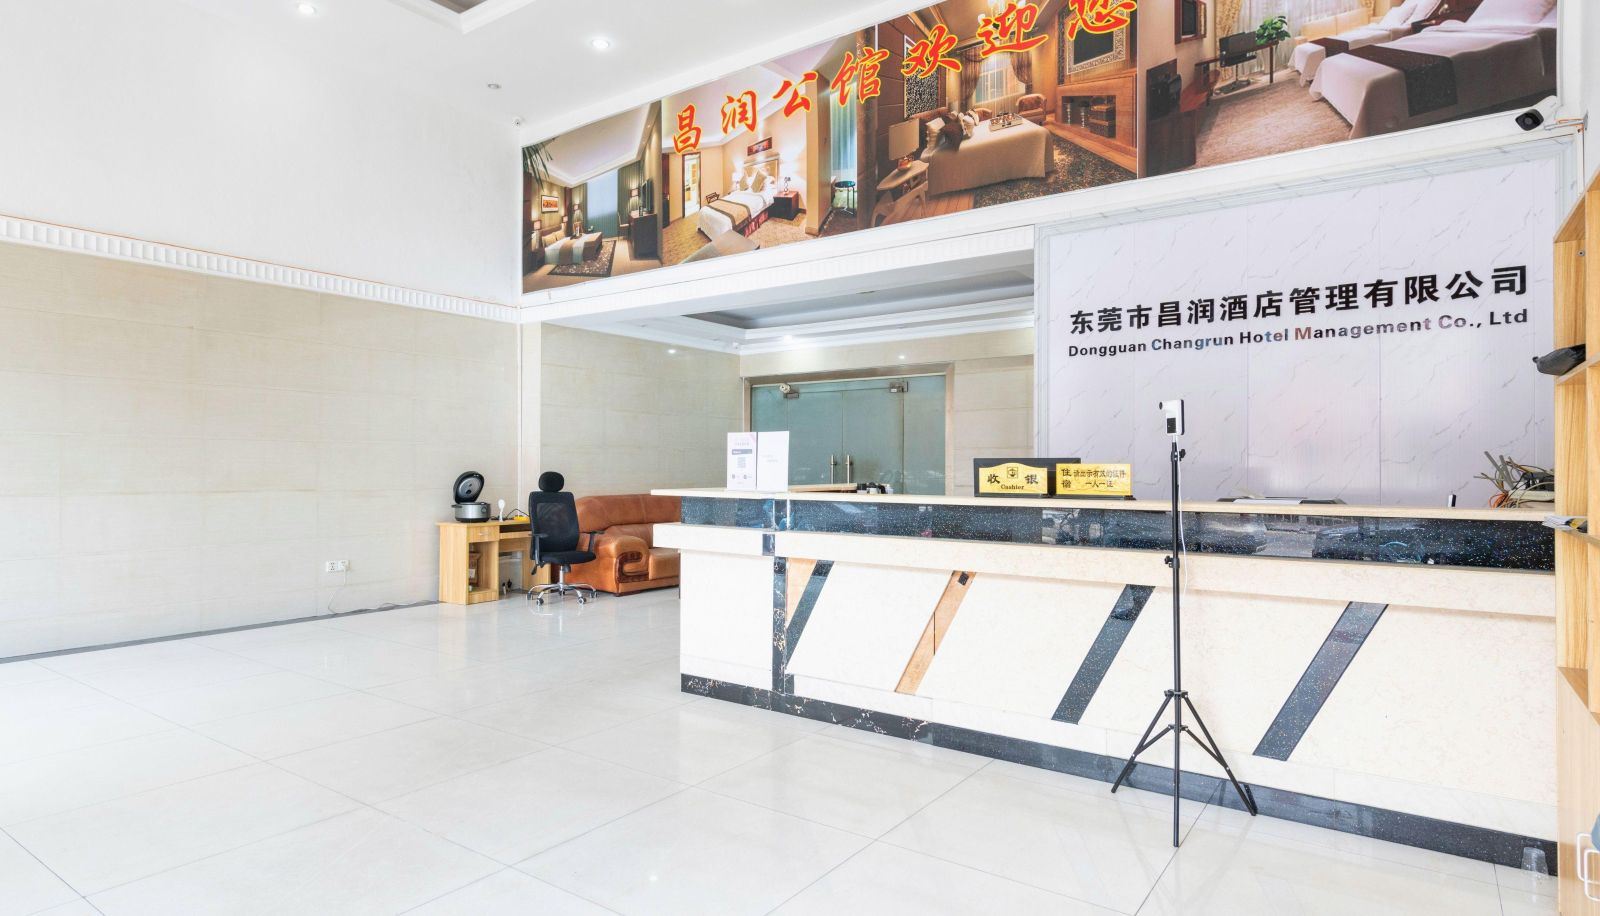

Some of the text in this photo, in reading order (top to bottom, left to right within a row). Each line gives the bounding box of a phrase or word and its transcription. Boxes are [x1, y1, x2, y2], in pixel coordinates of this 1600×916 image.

[1070, 265, 1527, 335] 东莞市昌润酒店管理有限公司
[1068, 308, 1528, 357] Dongguan Changrun Hotel Management Co., Ltd
[987, 473, 1039, 484] 收银
